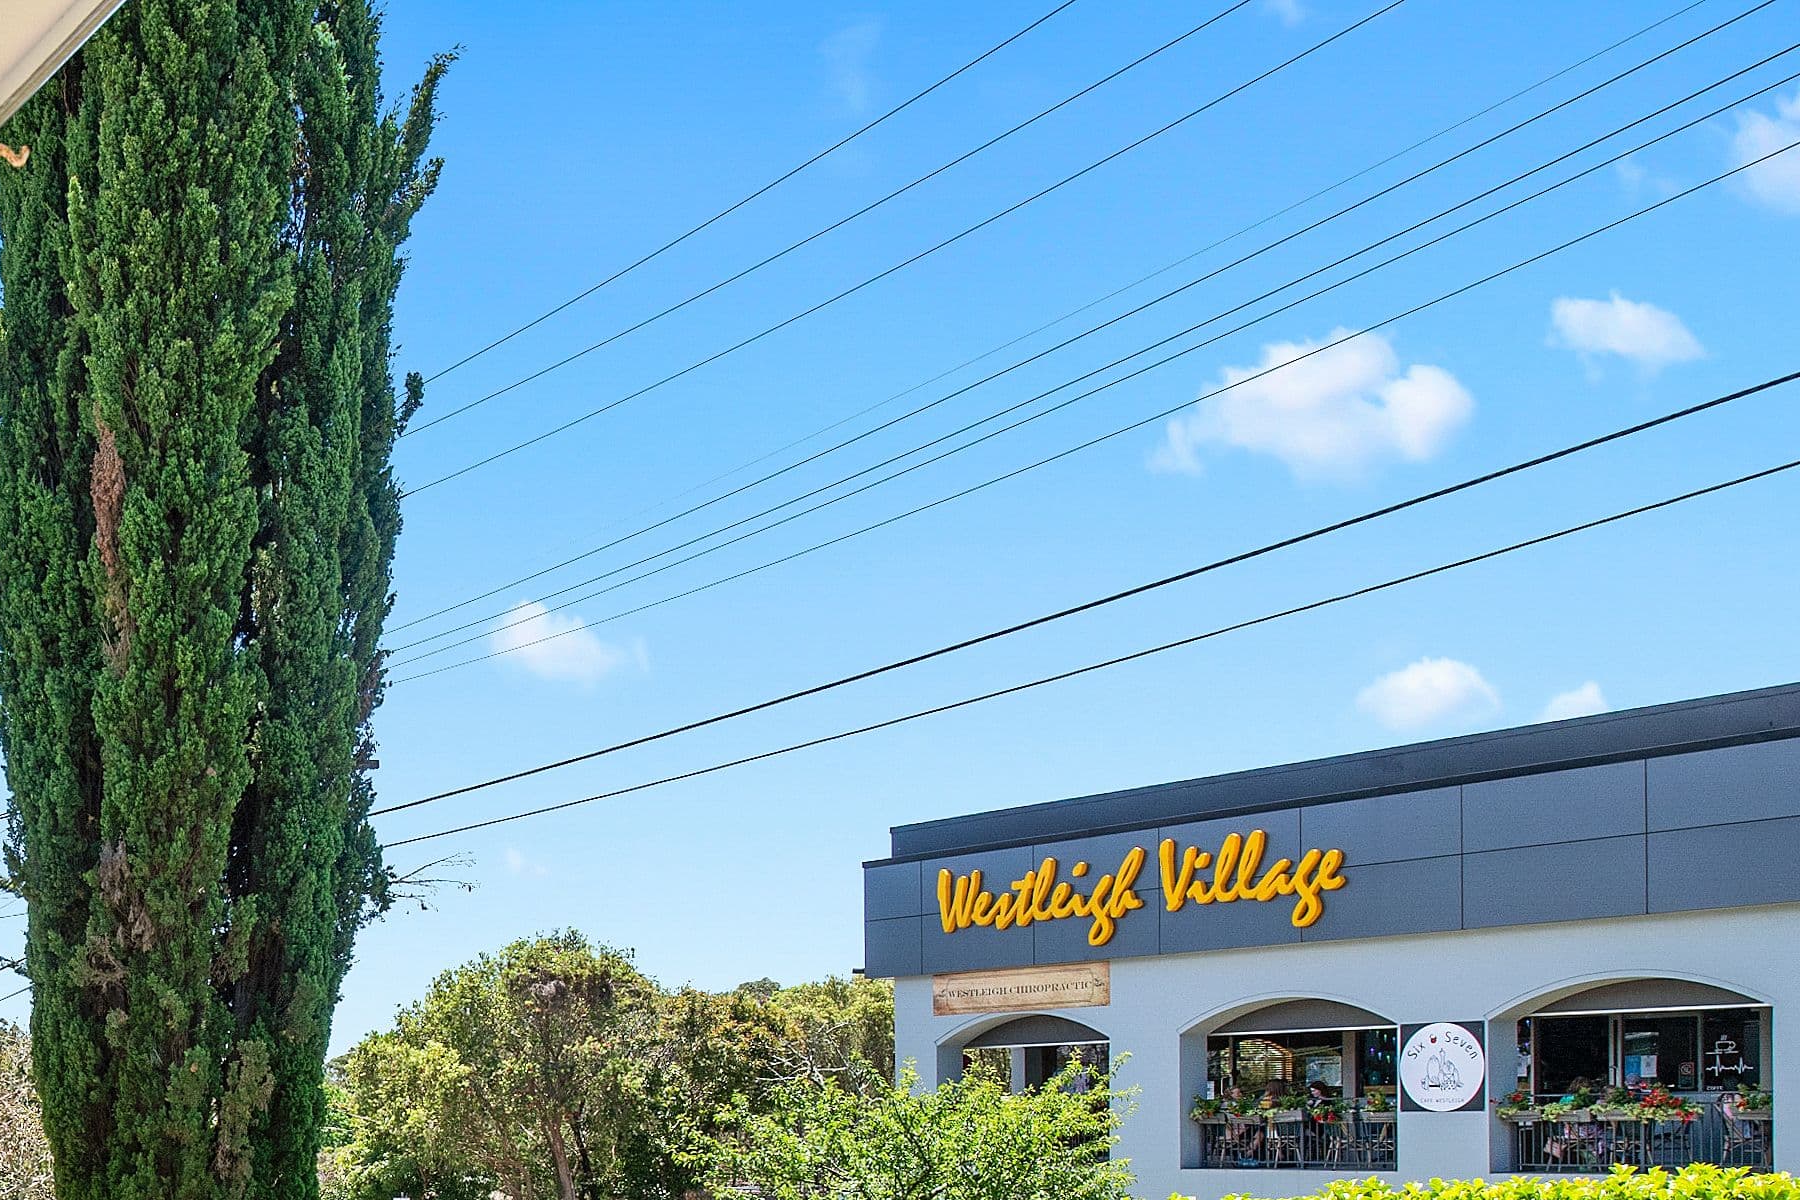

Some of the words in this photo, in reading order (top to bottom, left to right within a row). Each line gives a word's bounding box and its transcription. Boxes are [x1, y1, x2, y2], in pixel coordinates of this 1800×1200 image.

[938, 846, 1145, 947] Westleigh
[1158, 828, 1346, 928] Village
[948, 987, 1007, 998] WESTLEIGH
[1008, 981, 1093, 995] CHIROPRACTIC
[1407, 1042, 1426, 1060] Six
[1444, 1031, 1479, 1061] Seven
